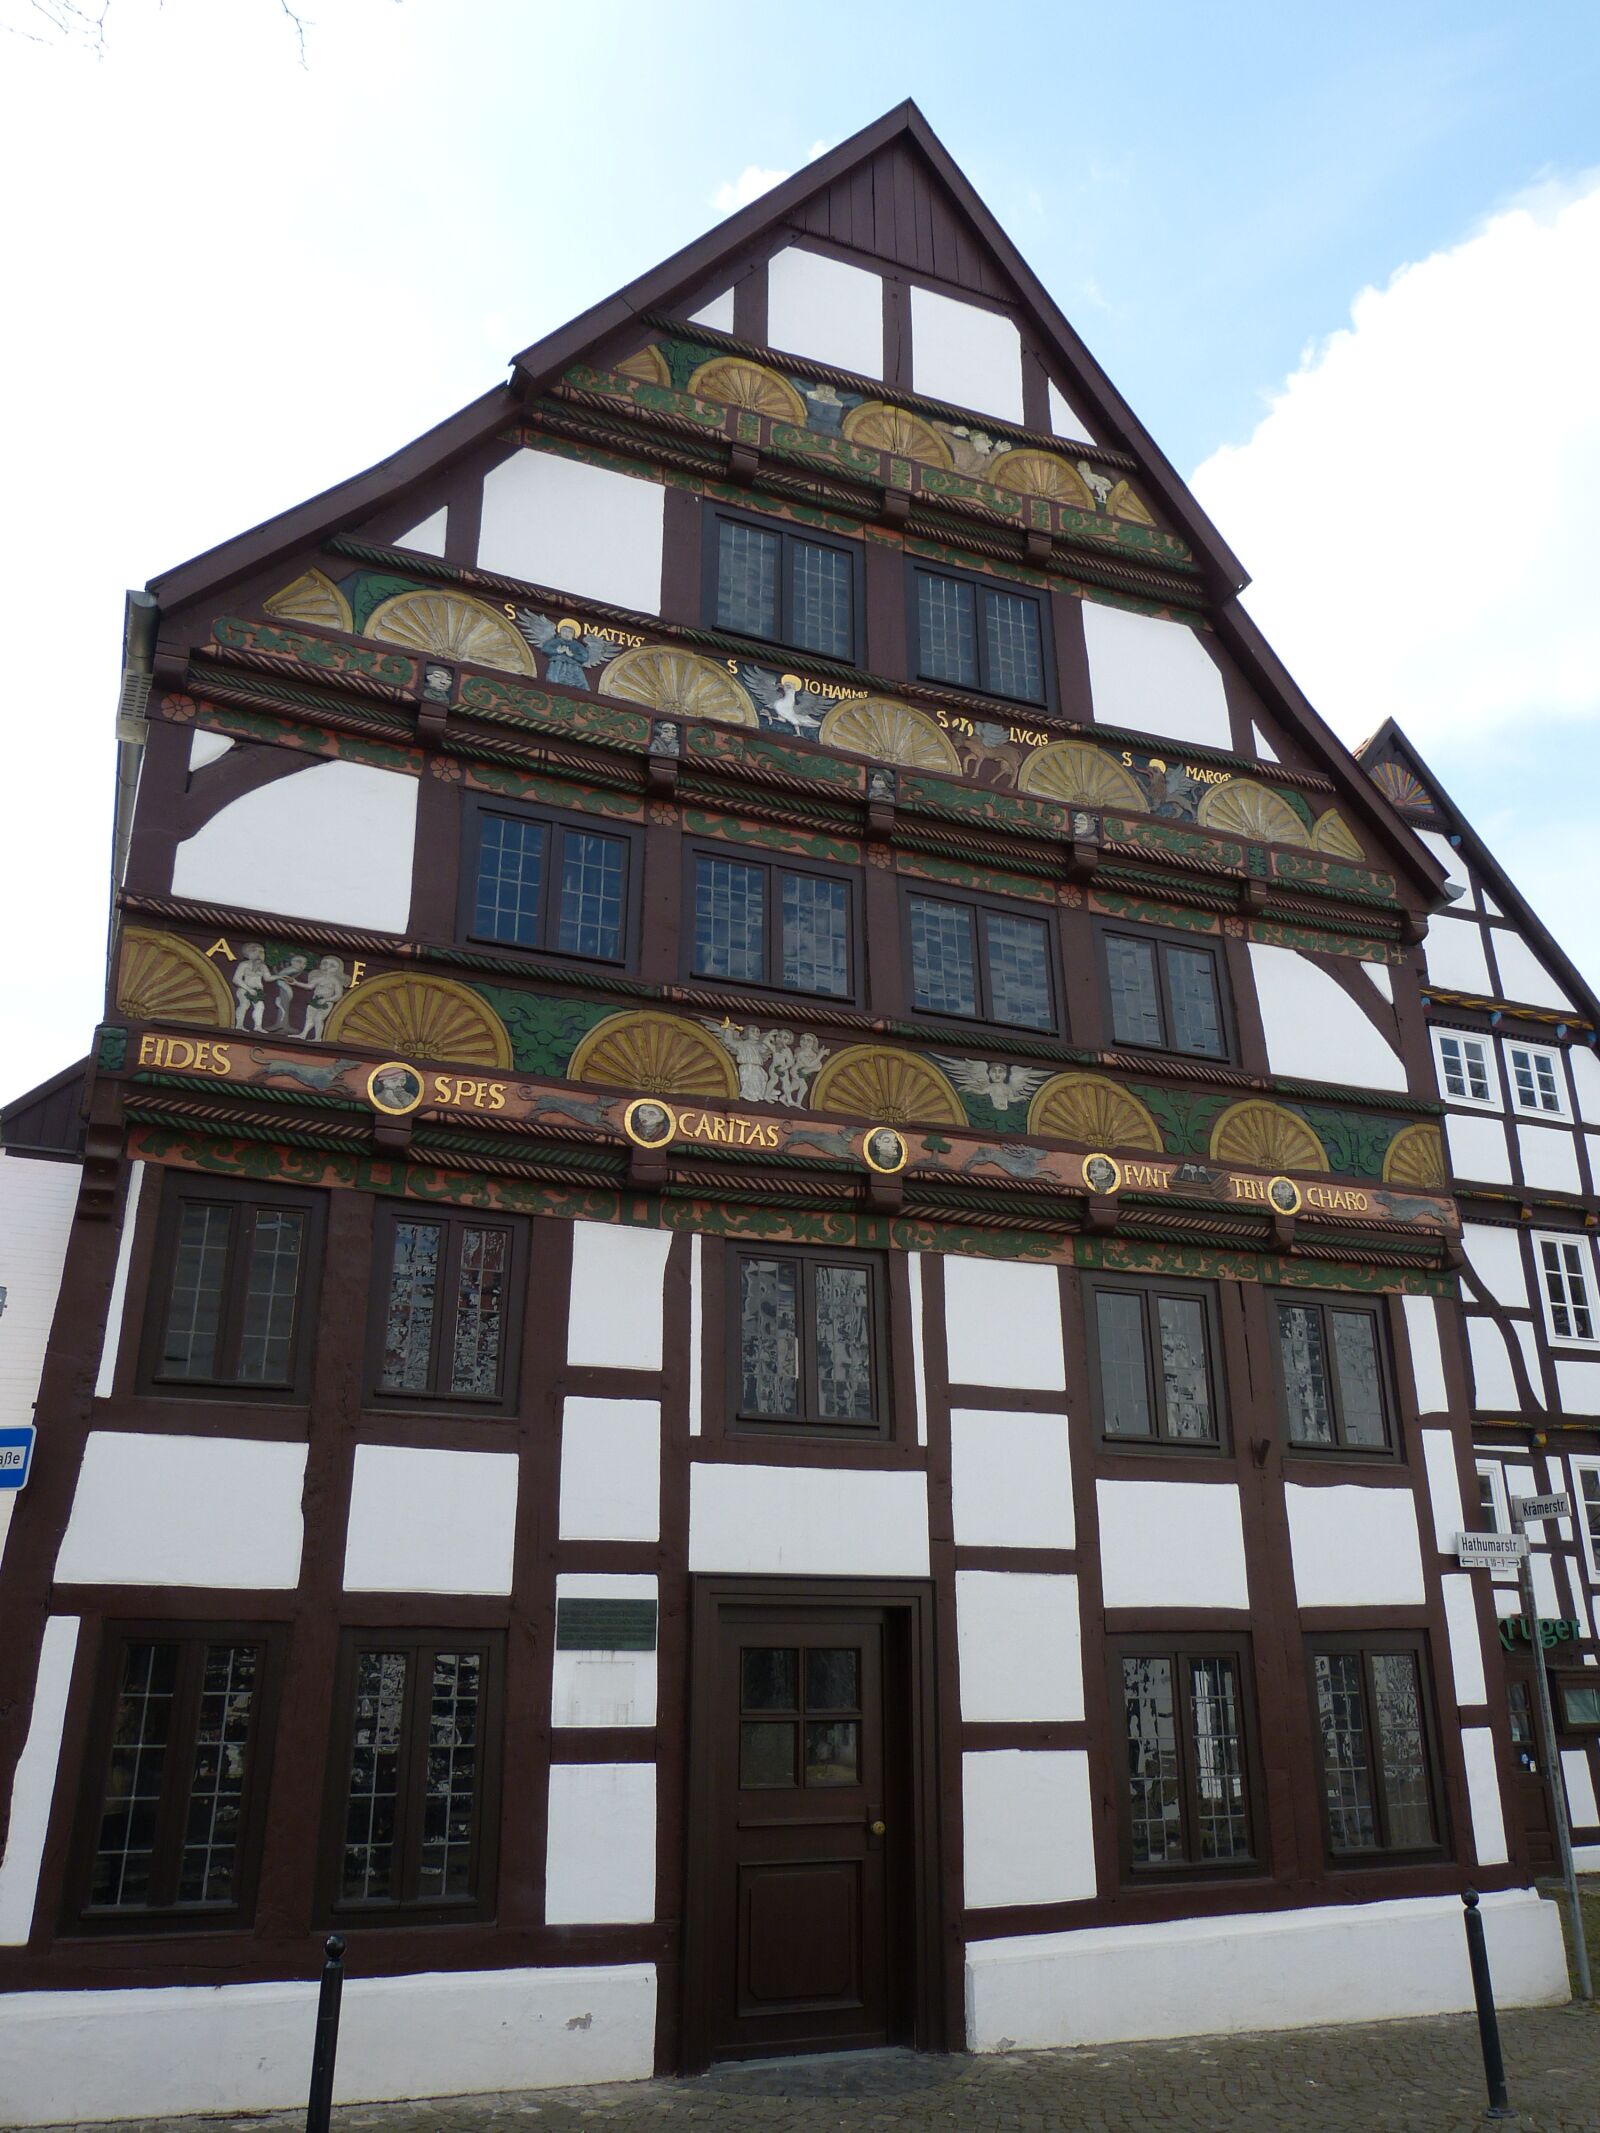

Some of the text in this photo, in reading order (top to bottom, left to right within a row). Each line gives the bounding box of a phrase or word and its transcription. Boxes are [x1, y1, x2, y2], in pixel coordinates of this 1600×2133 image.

[504, 603, 517, 620] S
[727, 659, 739, 675] S
[936, 710, 1049, 747] S LVCAS
[1122, 751, 1133, 768] S
[205, 938, 237, 961] A
[138, 1035, 231, 1075] FIDES
[434, 1076, 507, 1110] SPES
[678, 1112, 780, 1147] CARITAS
[1522, 1498, 1568, 1517] Krämerstr.
[1461, 1536, 1520, 1553] Hathumarstr.
